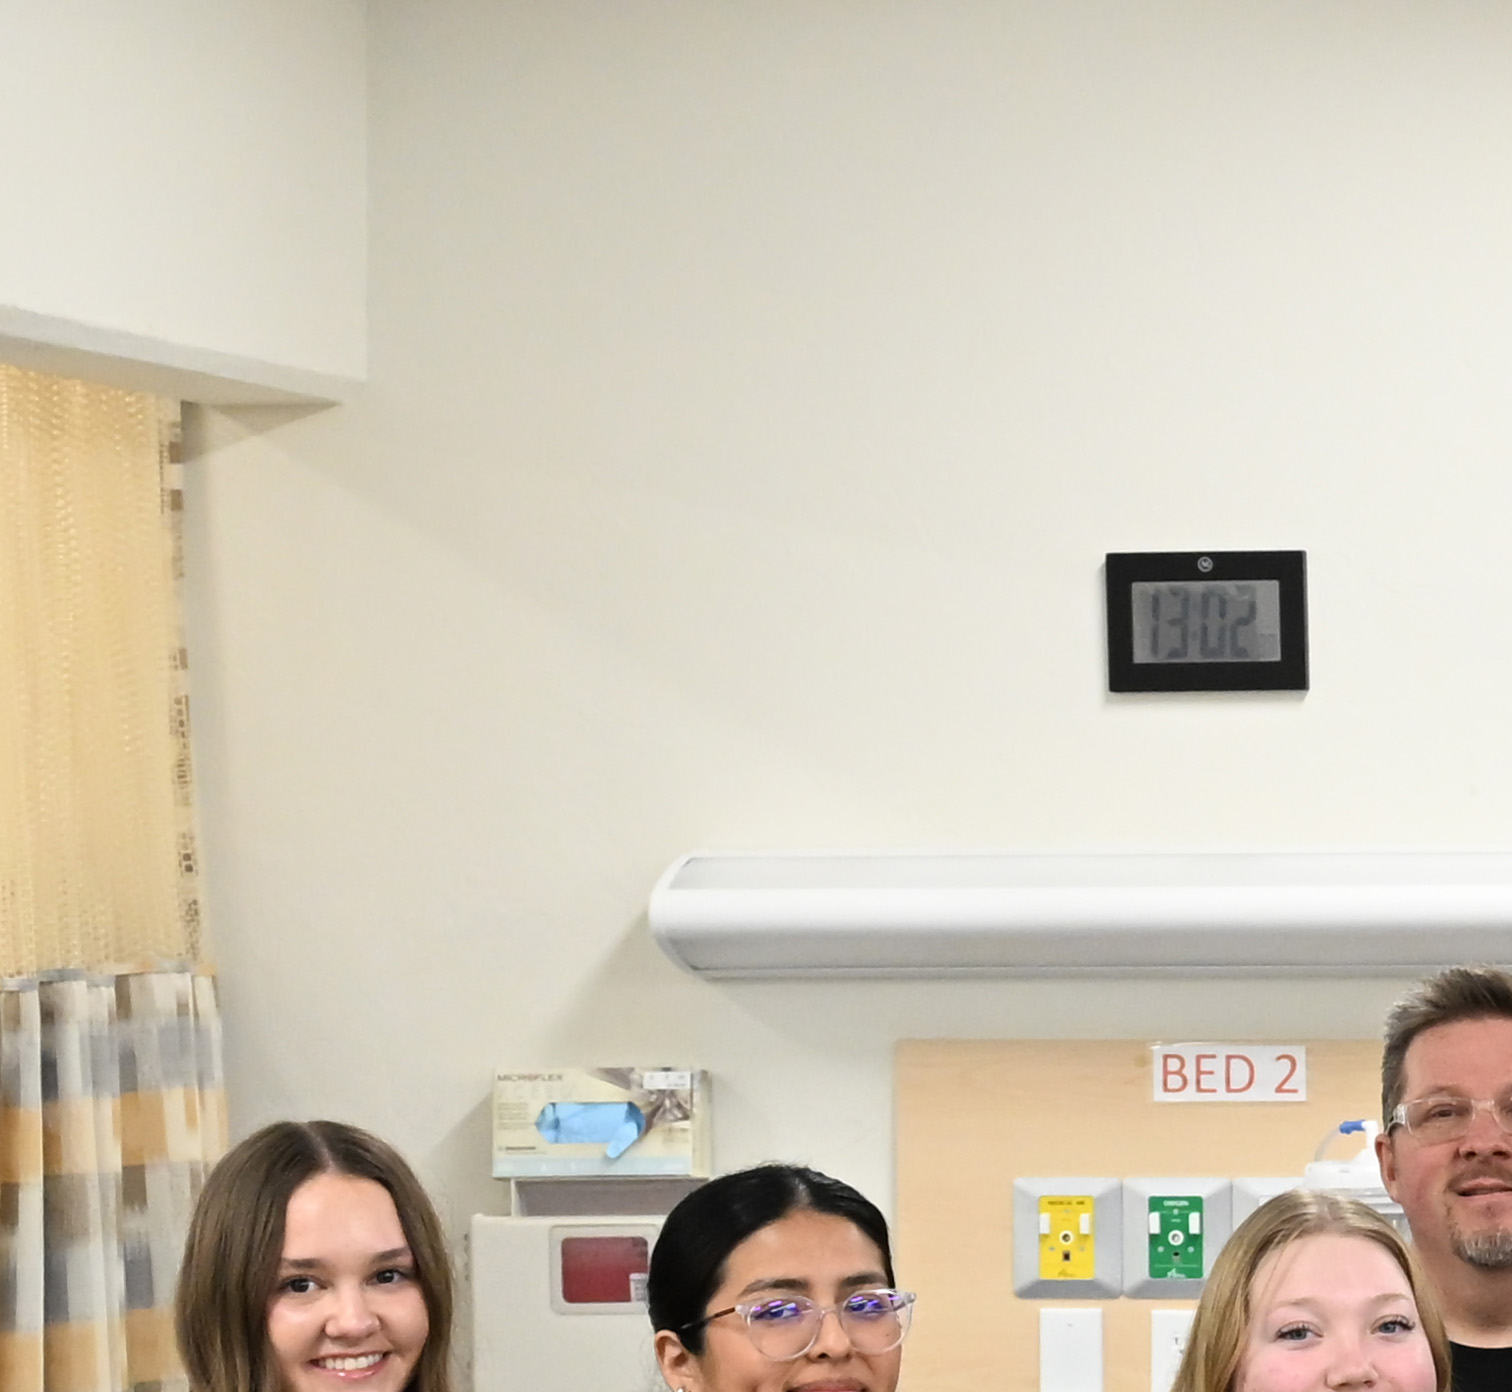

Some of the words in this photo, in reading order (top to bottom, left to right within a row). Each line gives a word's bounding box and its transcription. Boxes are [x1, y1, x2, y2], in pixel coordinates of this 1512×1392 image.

[1151, 584, 1257, 659] 13:02
[1162, 1054, 1255, 1093] BED
[1274, 1054, 1299, 1093] 2
